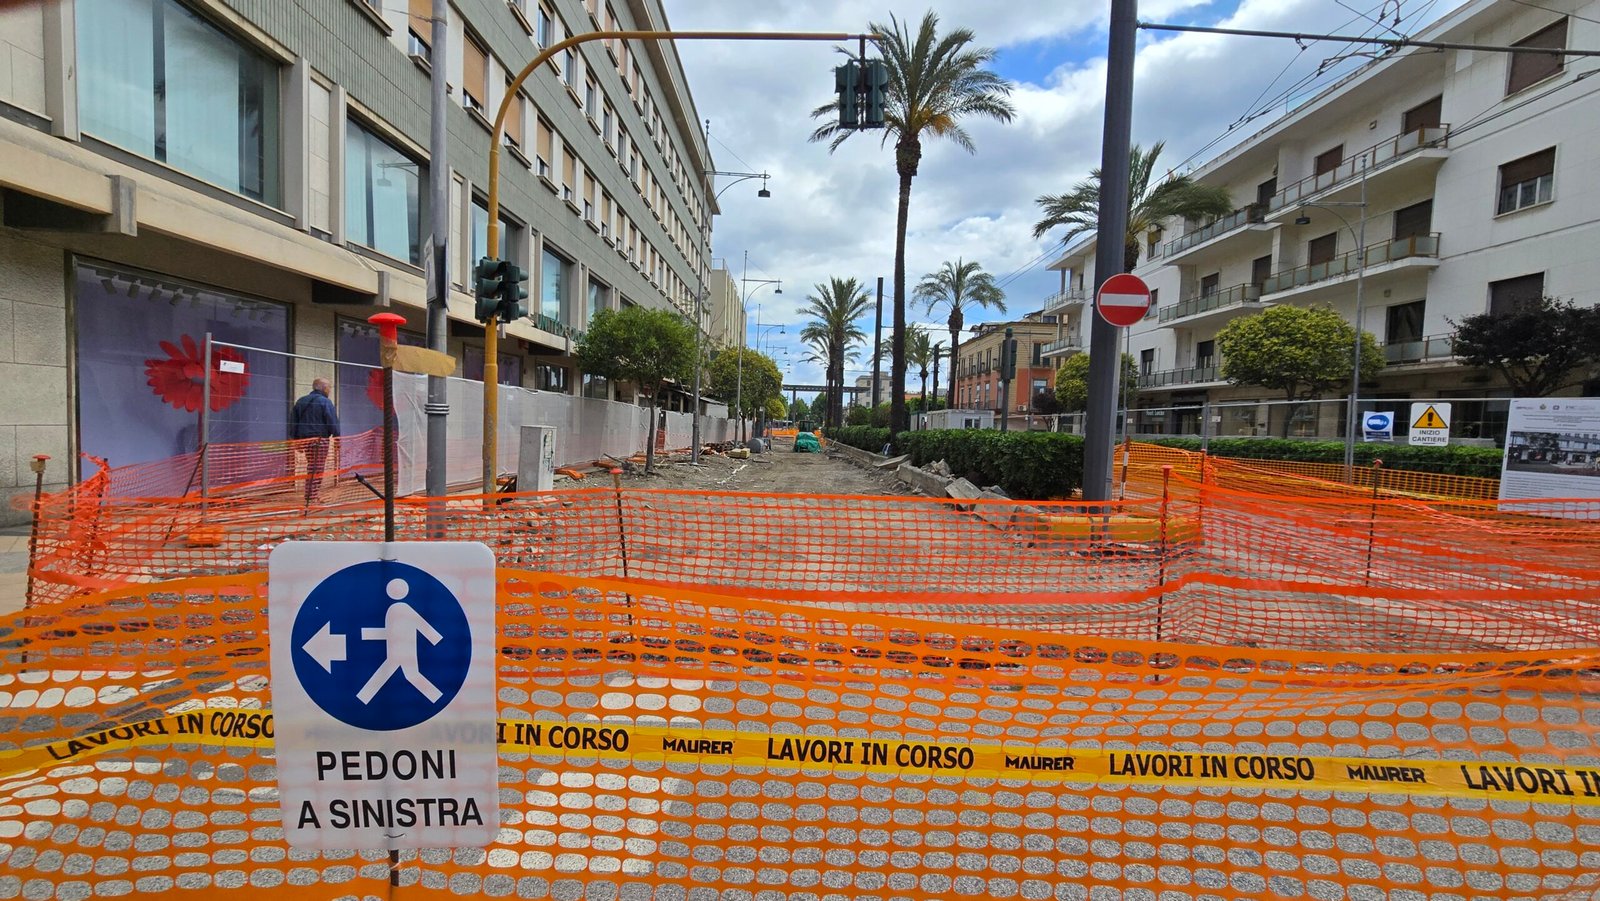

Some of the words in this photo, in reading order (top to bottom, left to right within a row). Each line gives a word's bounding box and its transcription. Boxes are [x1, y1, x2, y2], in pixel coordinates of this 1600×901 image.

[46, 719, 169, 760] LAVORI
[177, 713, 204, 734] IN
[210, 711, 275, 739] CORSO
[514, 723, 542, 746] IN
[548, 725, 629, 752] CORSO
[662, 737, 733, 755] MAURER
[316, 749, 456, 781] PEDONI
[767, 737, 854, 764] LAVORI
[860, 742, 888, 766] IN
[895, 743, 974, 770] CORSO
[1005, 755, 1074, 771] MAURER
[1109, 753, 1194, 777] LAVORI
[1200, 755, 1228, 778] IN
[1234, 756, 1315, 781] CORSO
[1347, 765, 1425, 783] MAURER
[1460, 765, 1575, 796] LAVORI
[297, 800, 322, 829] A
[329, 797, 484, 828] SINISTRA
